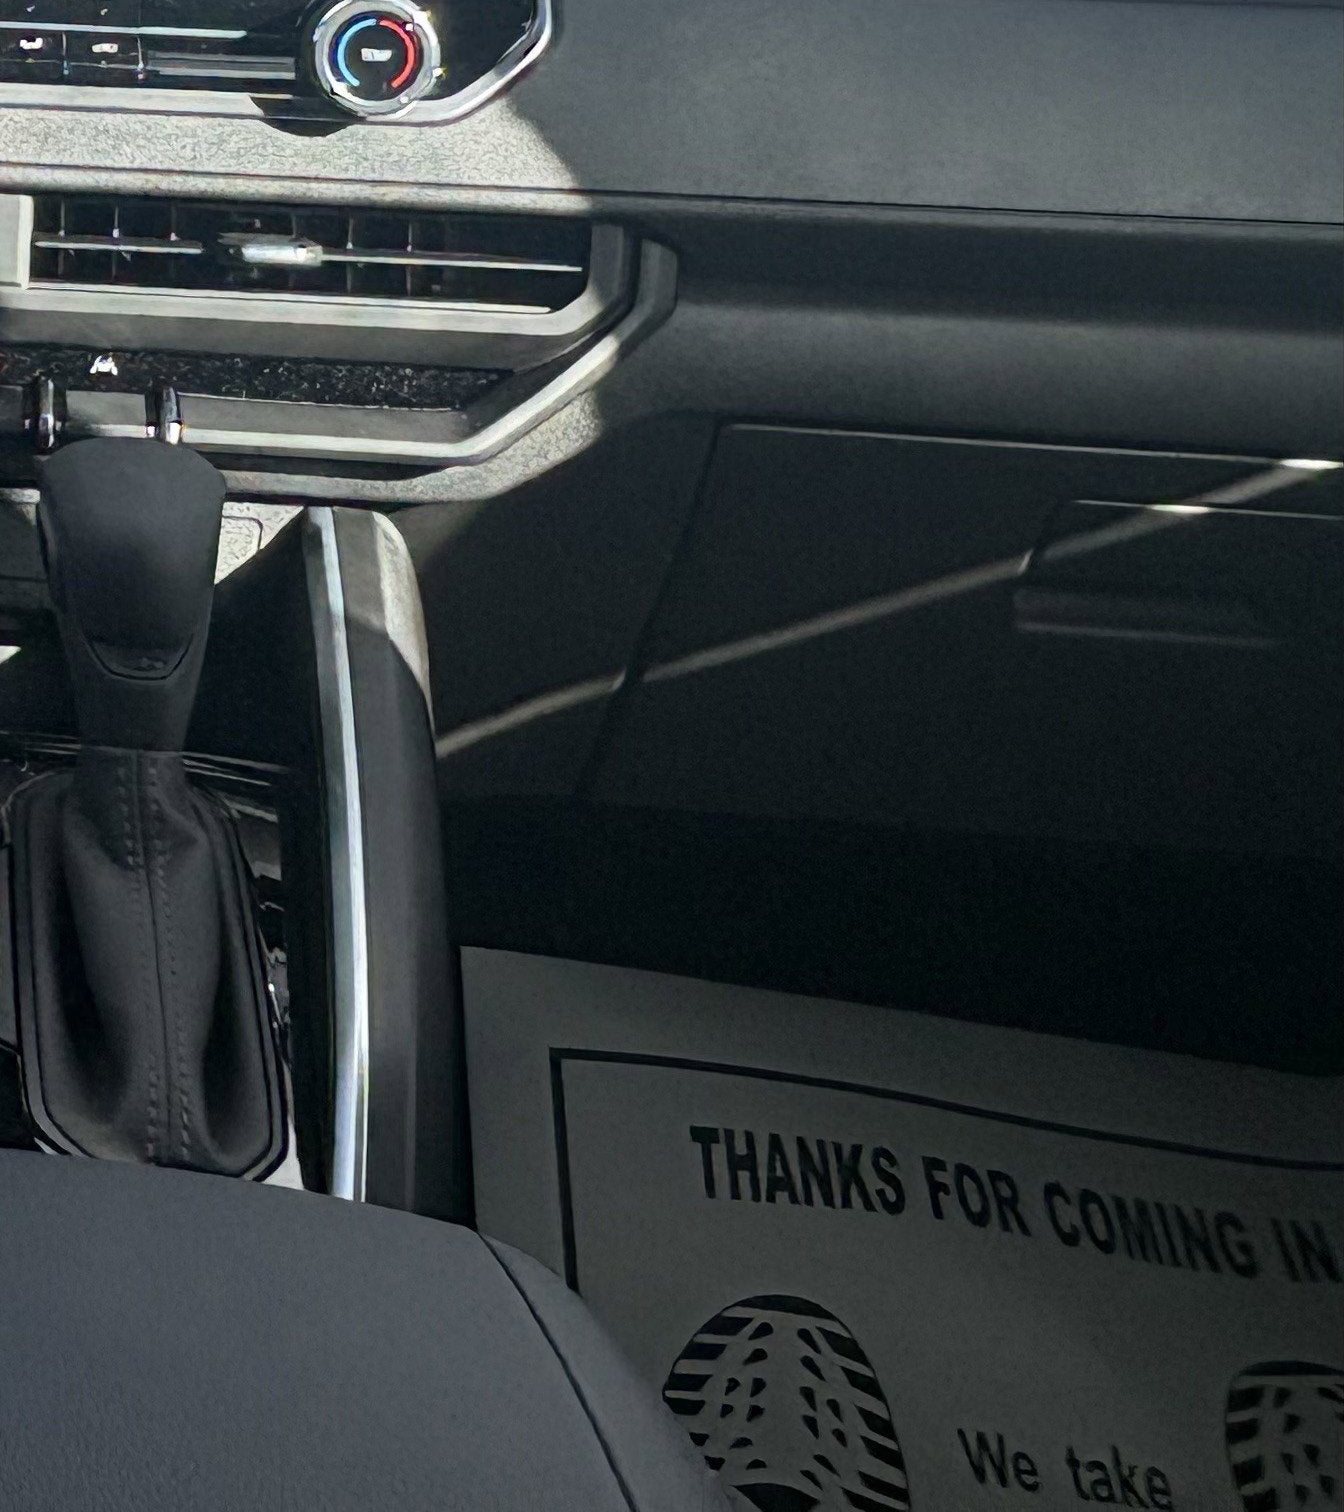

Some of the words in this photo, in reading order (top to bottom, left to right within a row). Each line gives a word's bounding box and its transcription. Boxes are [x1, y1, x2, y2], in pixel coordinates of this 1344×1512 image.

[689, 1125, 905, 1215] THANKS
[921, 1155, 1032, 1237] FOR
[1043, 1181, 1260, 1280] COMING
[1270, 1217, 1344, 1284] IN
[956, 1428, 1041, 1493] We
[1065, 1444, 1173, 1512] take
